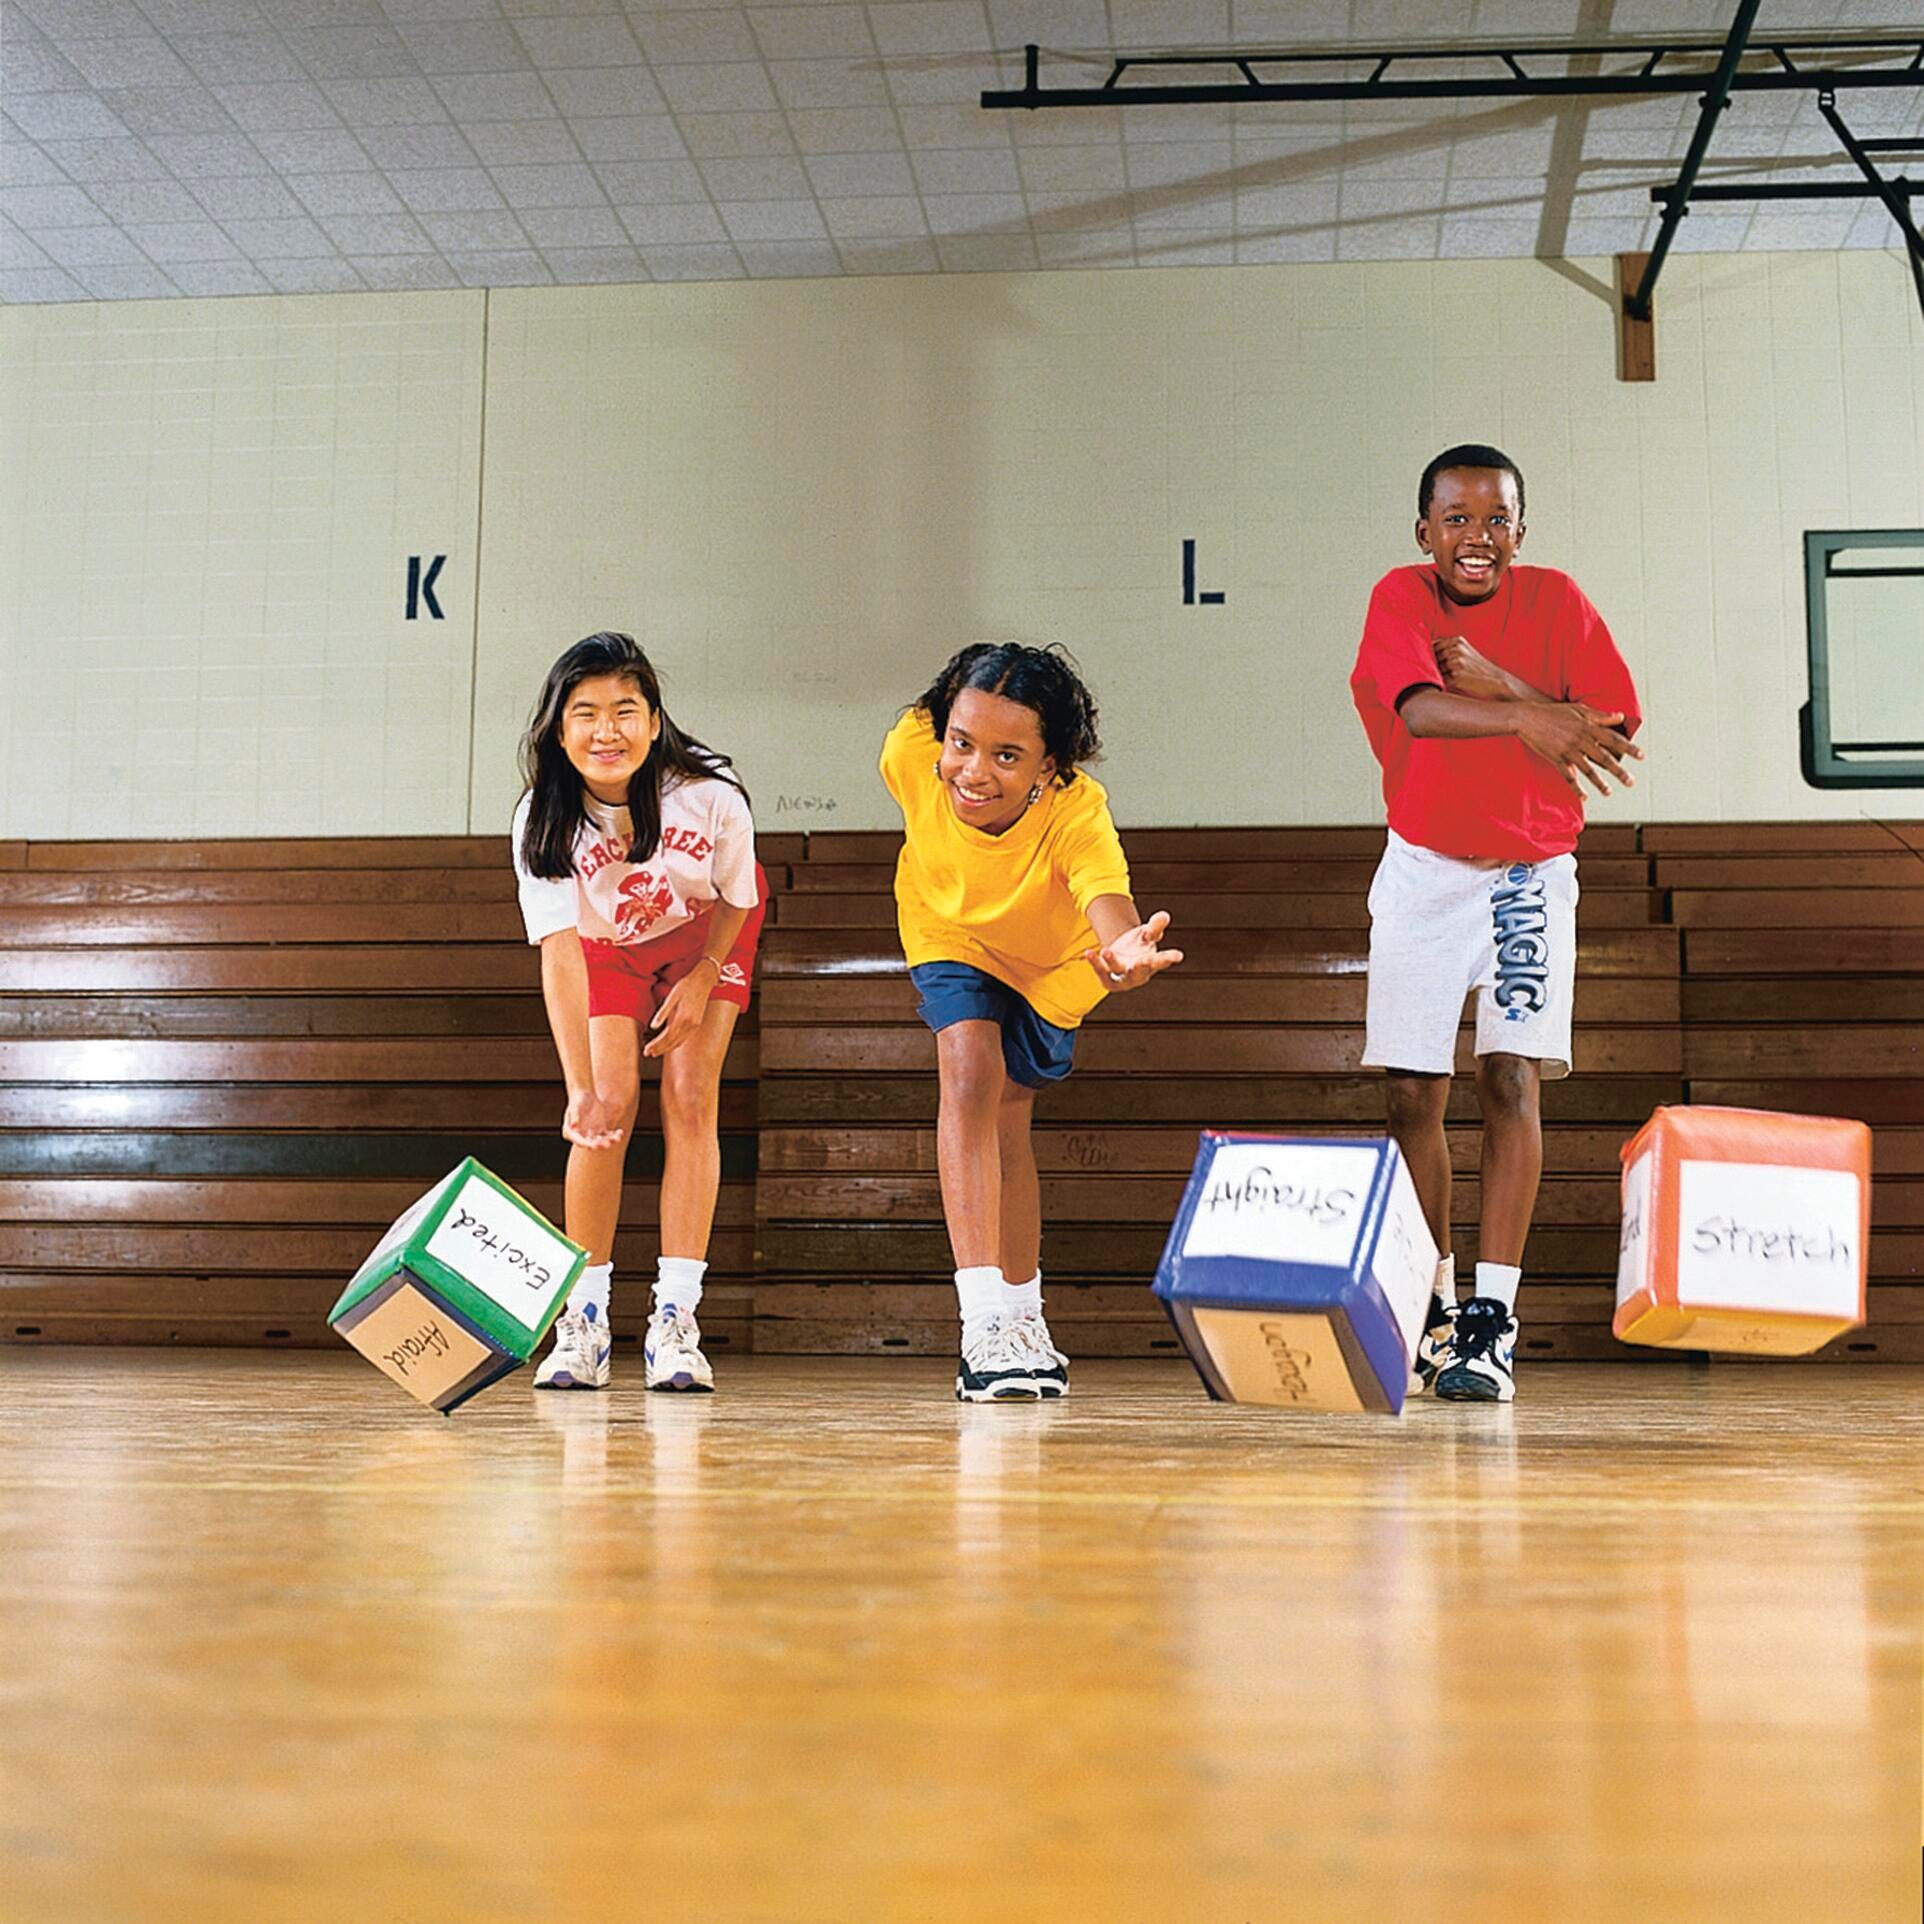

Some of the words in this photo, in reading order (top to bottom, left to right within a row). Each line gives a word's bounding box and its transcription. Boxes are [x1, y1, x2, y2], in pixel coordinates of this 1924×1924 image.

[405, 555, 447, 620] K
[1183, 539, 1225, 605] L
[1490, 879, 1549, 1013] MAGIC
[1204, 1166, 1355, 1221] Straight
[451, 1208, 551, 1290] Excited
[1692, 1215, 1849, 1264] Stretch
[383, 1320, 451, 1377] Afraid
